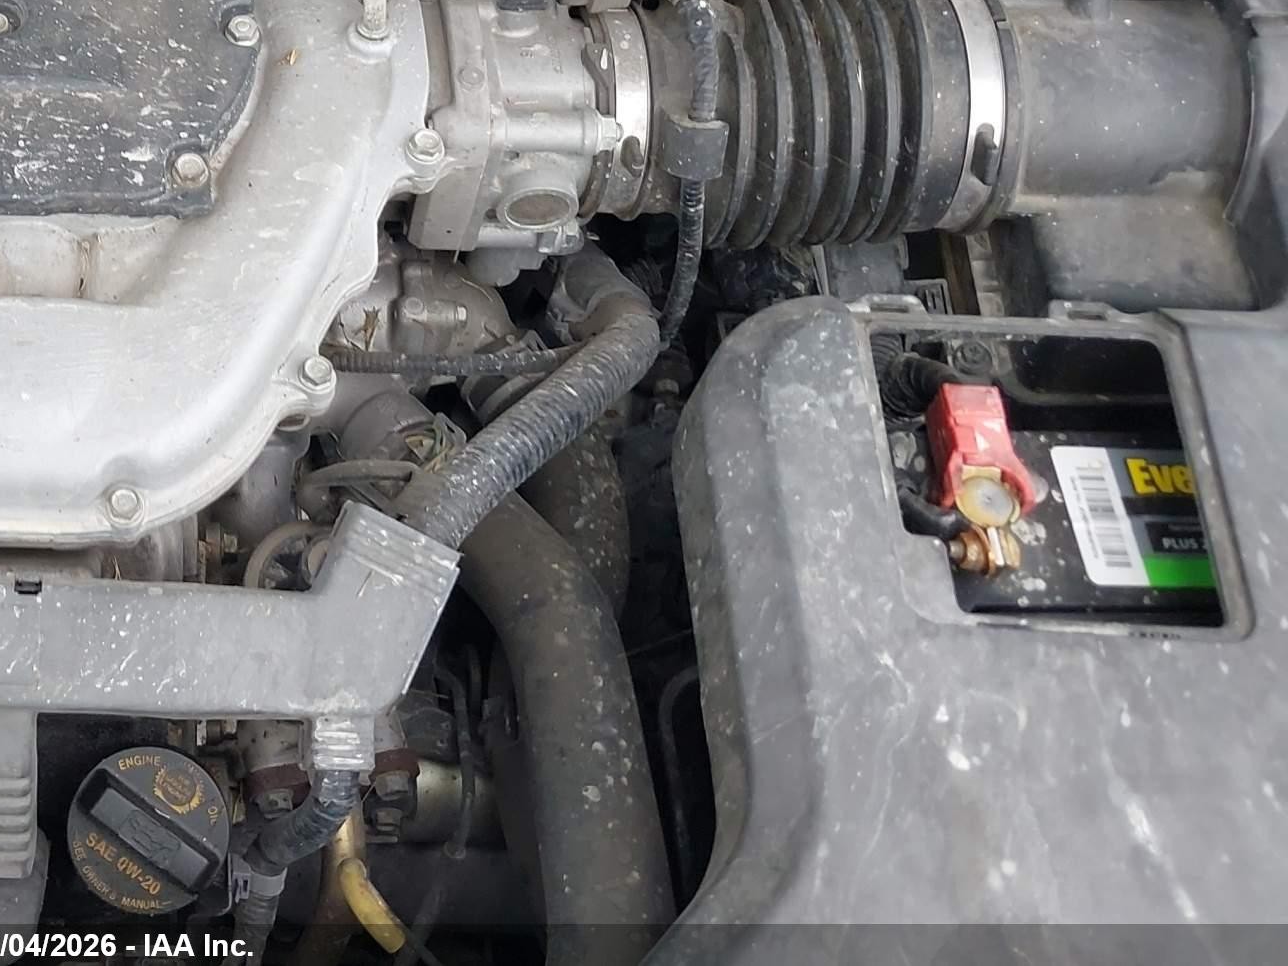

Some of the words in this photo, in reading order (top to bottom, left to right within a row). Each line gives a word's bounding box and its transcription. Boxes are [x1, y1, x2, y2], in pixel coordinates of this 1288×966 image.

[1162, 537, 1198, 549] PLUS
[118, 755, 161, 770] ENGINE
[73, 841, 87, 861] SEE
[82, 865, 117, 900] OWNERS
[121, 897, 160, 910] MANUAL
[86, 833, 118, 862] SAE
[117, 857, 161, 895] 0W-20
